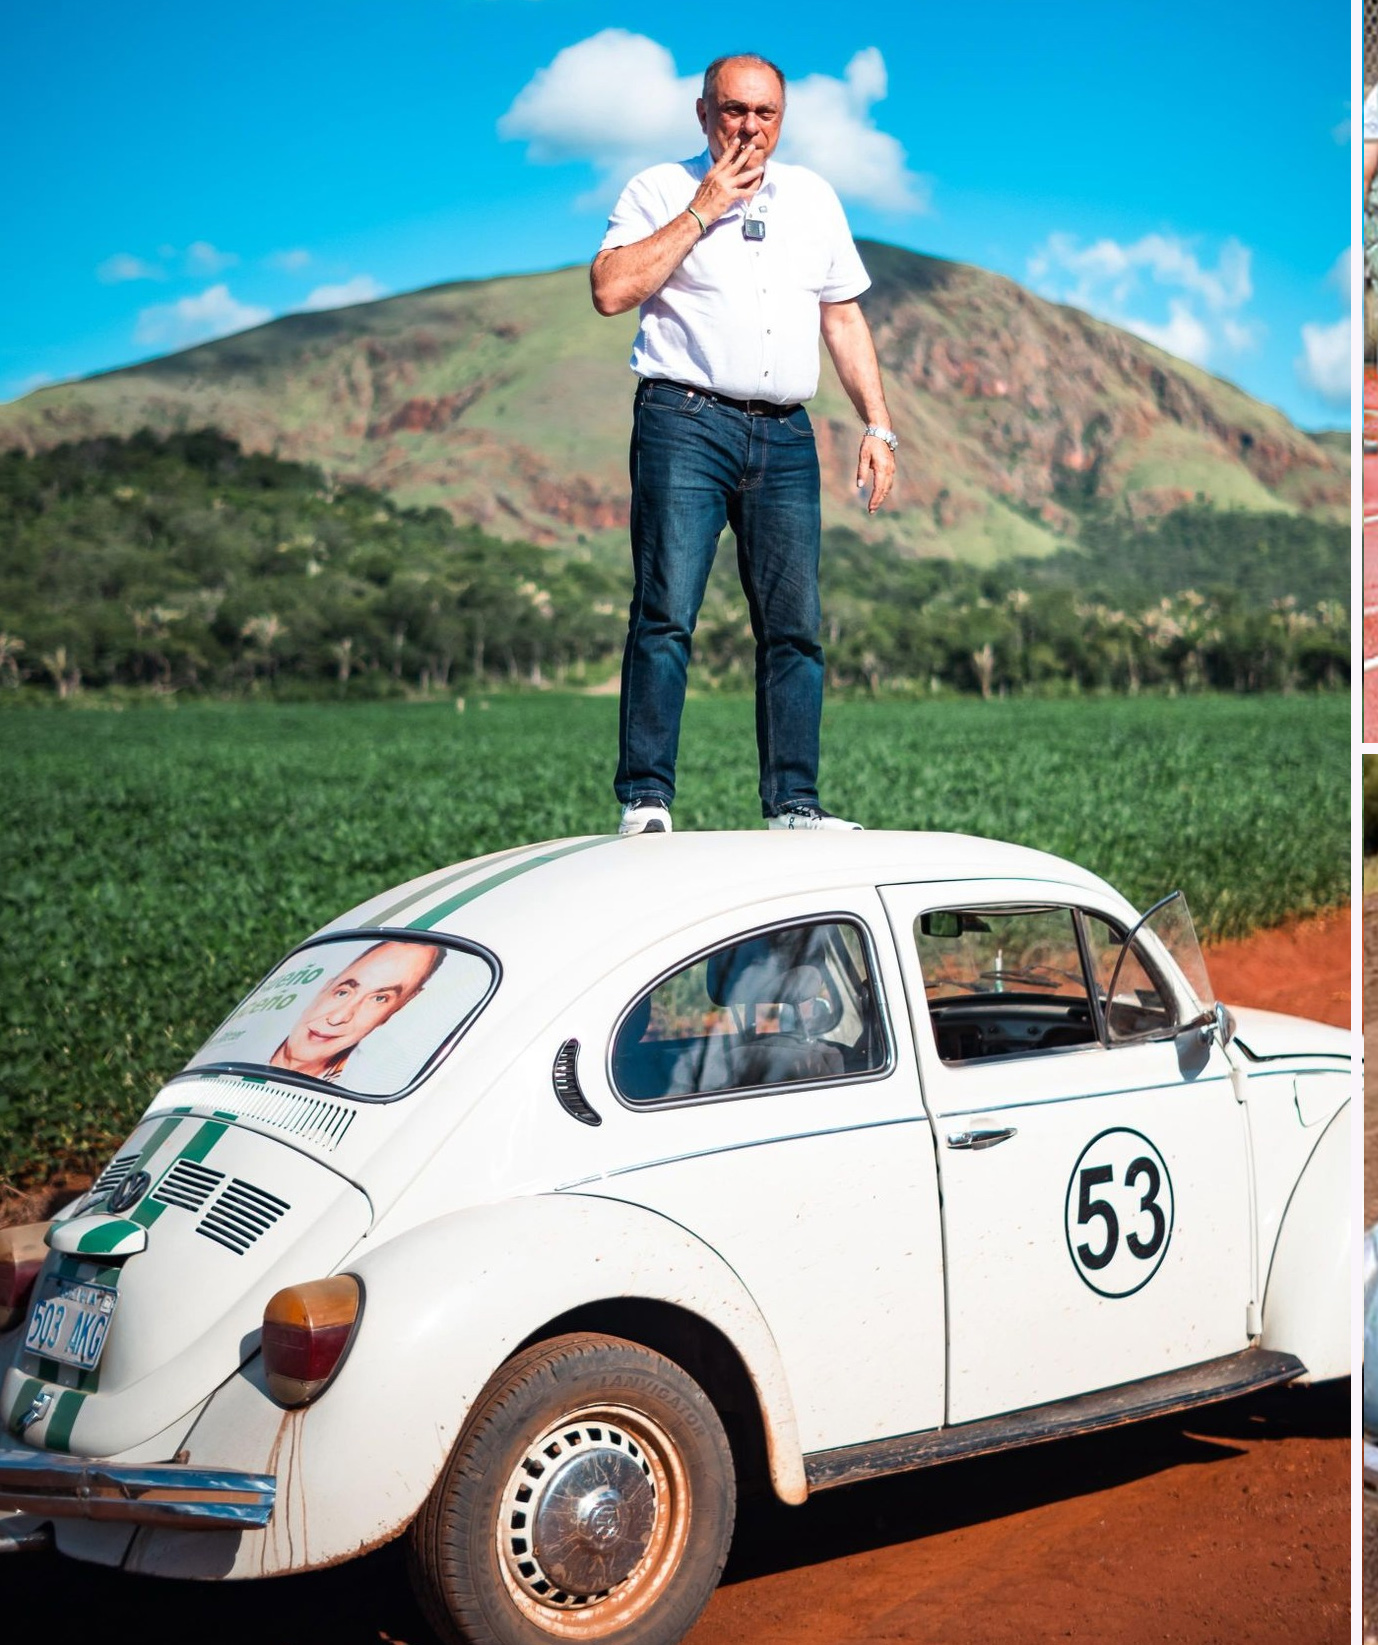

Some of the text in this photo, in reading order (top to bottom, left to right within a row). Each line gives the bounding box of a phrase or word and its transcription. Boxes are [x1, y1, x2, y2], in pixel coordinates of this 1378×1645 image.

[1076, 1156, 1166, 1270] 53
[28, 1299, 107, 1359] 503 AKG
